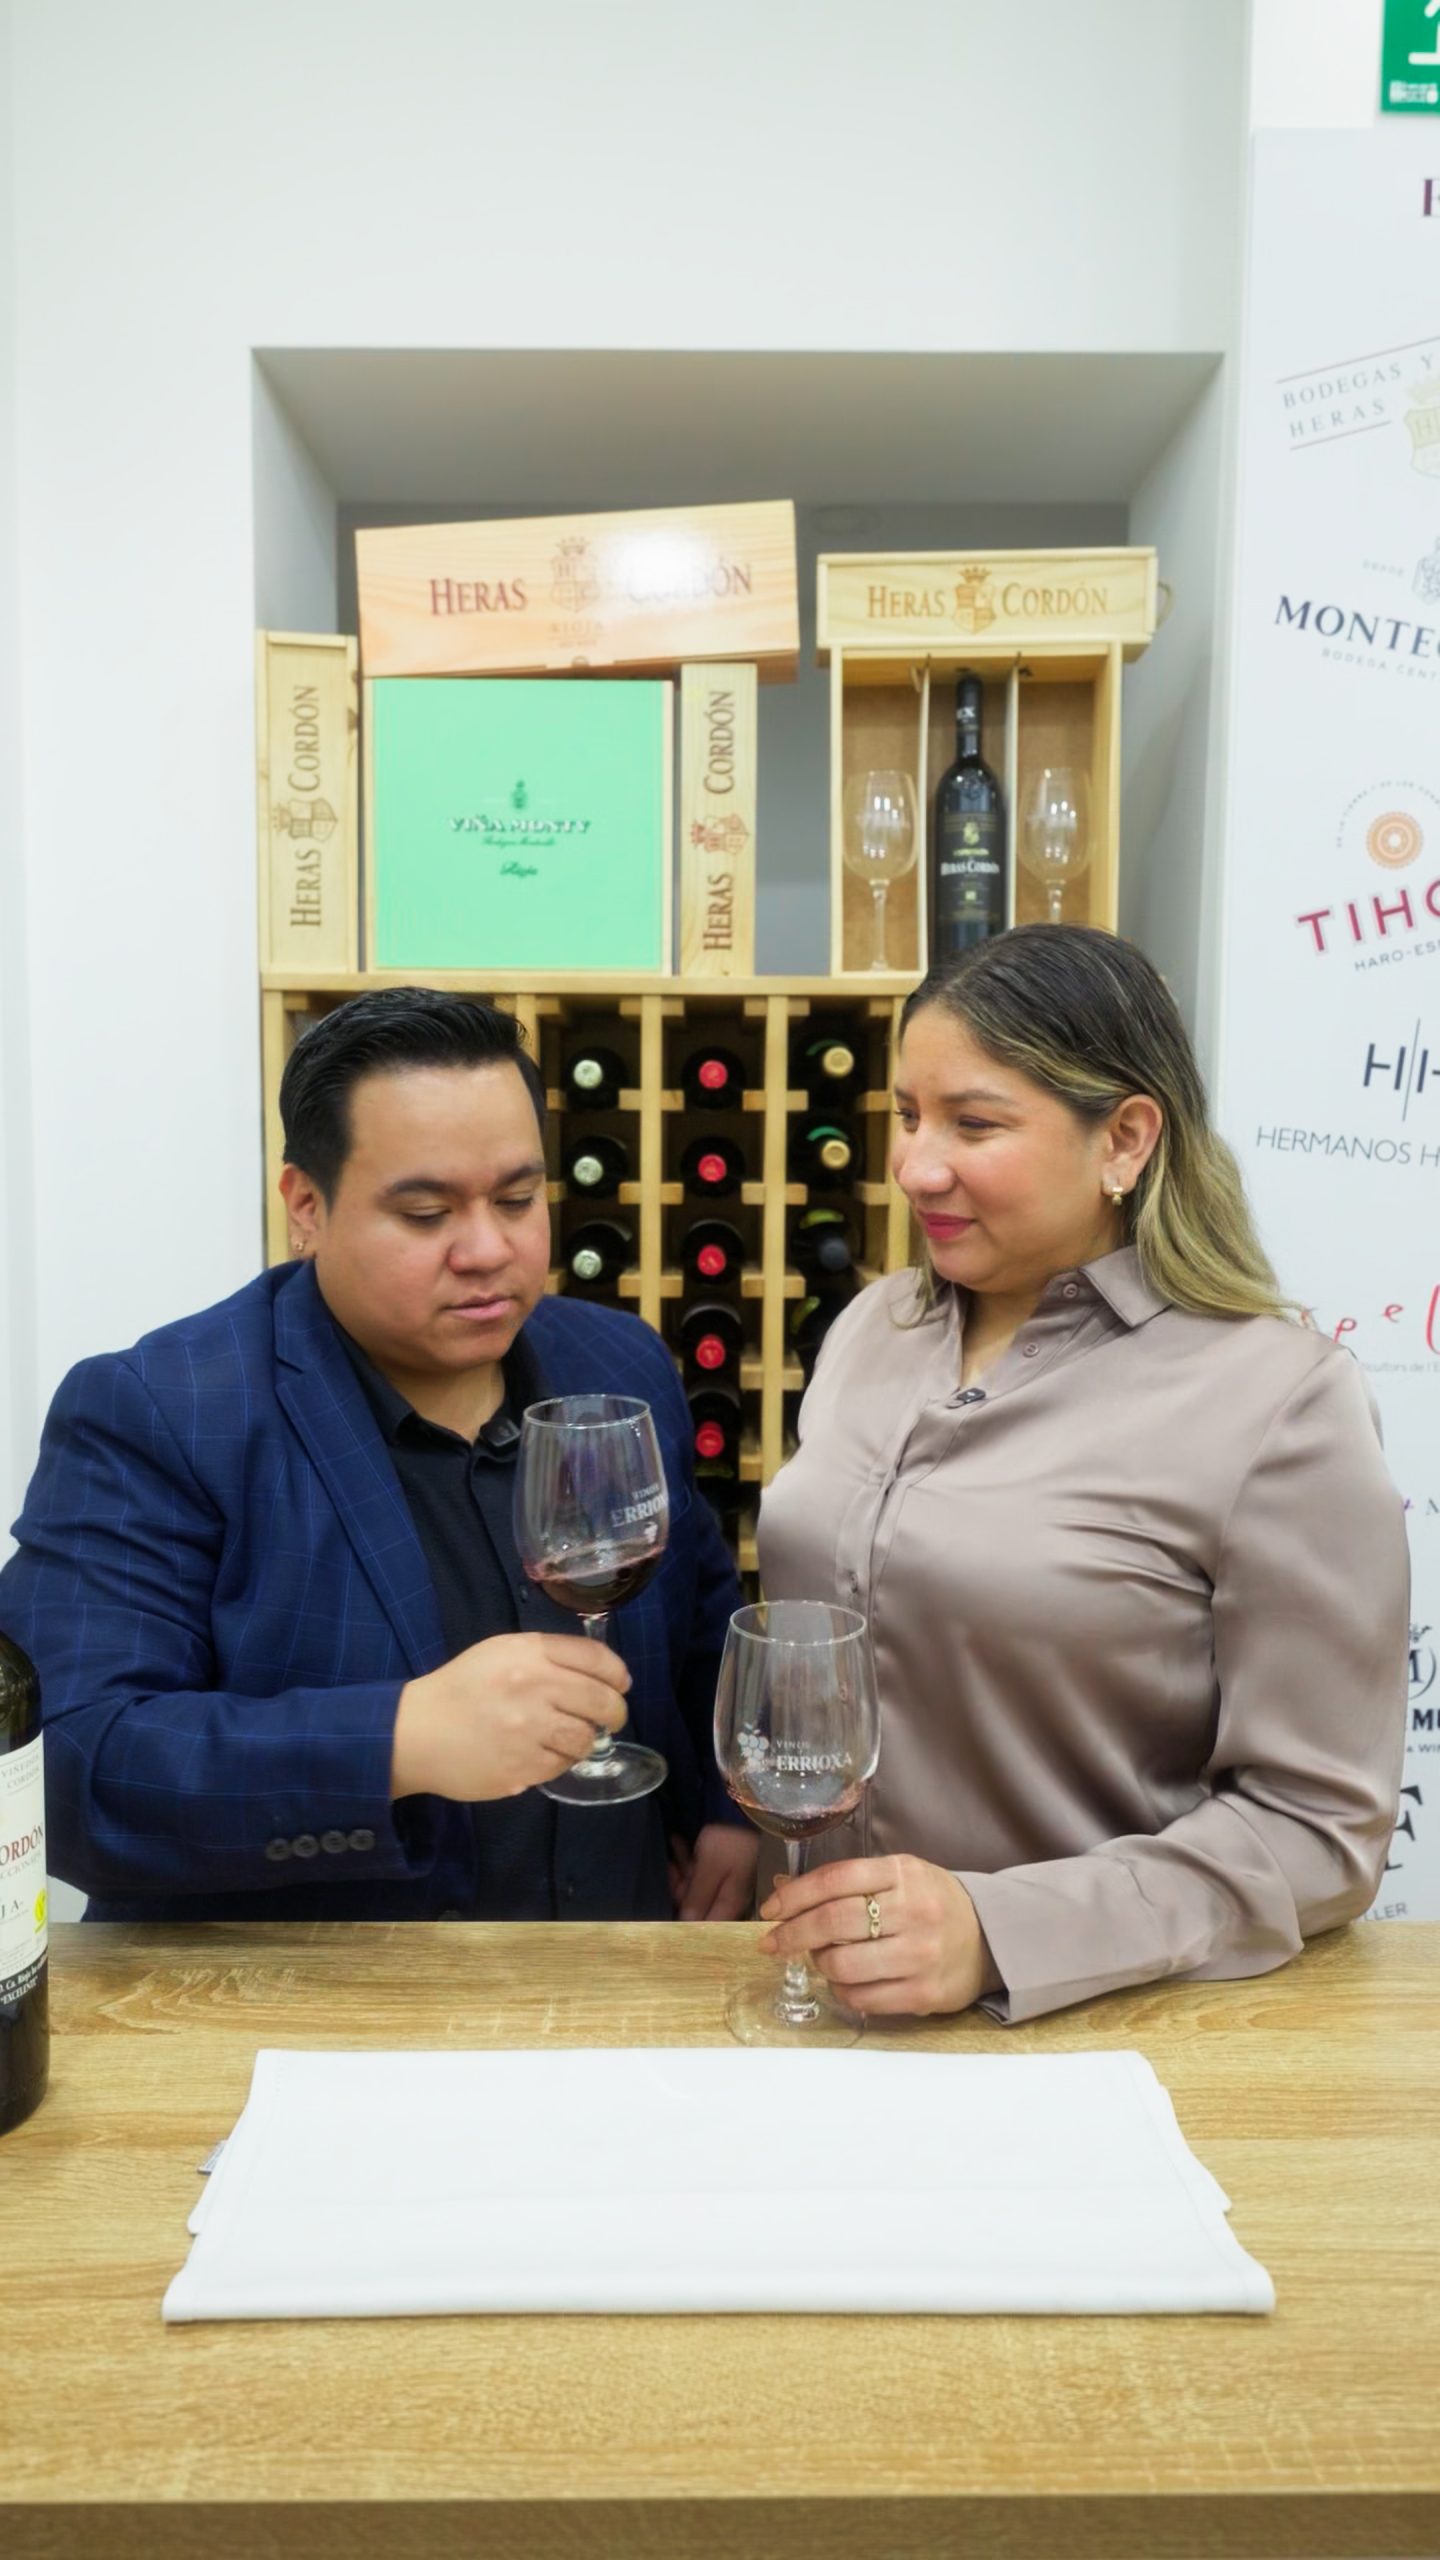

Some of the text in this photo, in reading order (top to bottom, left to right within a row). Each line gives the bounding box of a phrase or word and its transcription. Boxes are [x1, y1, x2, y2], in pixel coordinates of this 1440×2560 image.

[1283, 353, 1433, 409] BODEGAS Y
[1289, 398, 1385, 438] HERAS
[430, 578, 527, 615] HERAS
[867, 581, 1108, 618] HERAS CORDÓN
[1275, 595, 1440, 658] MONTE
[288, 685, 321, 792] CORDÓN
[703, 690, 735, 794] CORDÓN
[290, 848, 321, 927] HERAS
[702, 872, 734, 950] HERAS
[1257, 1126, 1411, 1164] HERMANOS
[776, 1752, 853, 1772] ERRIOXA
